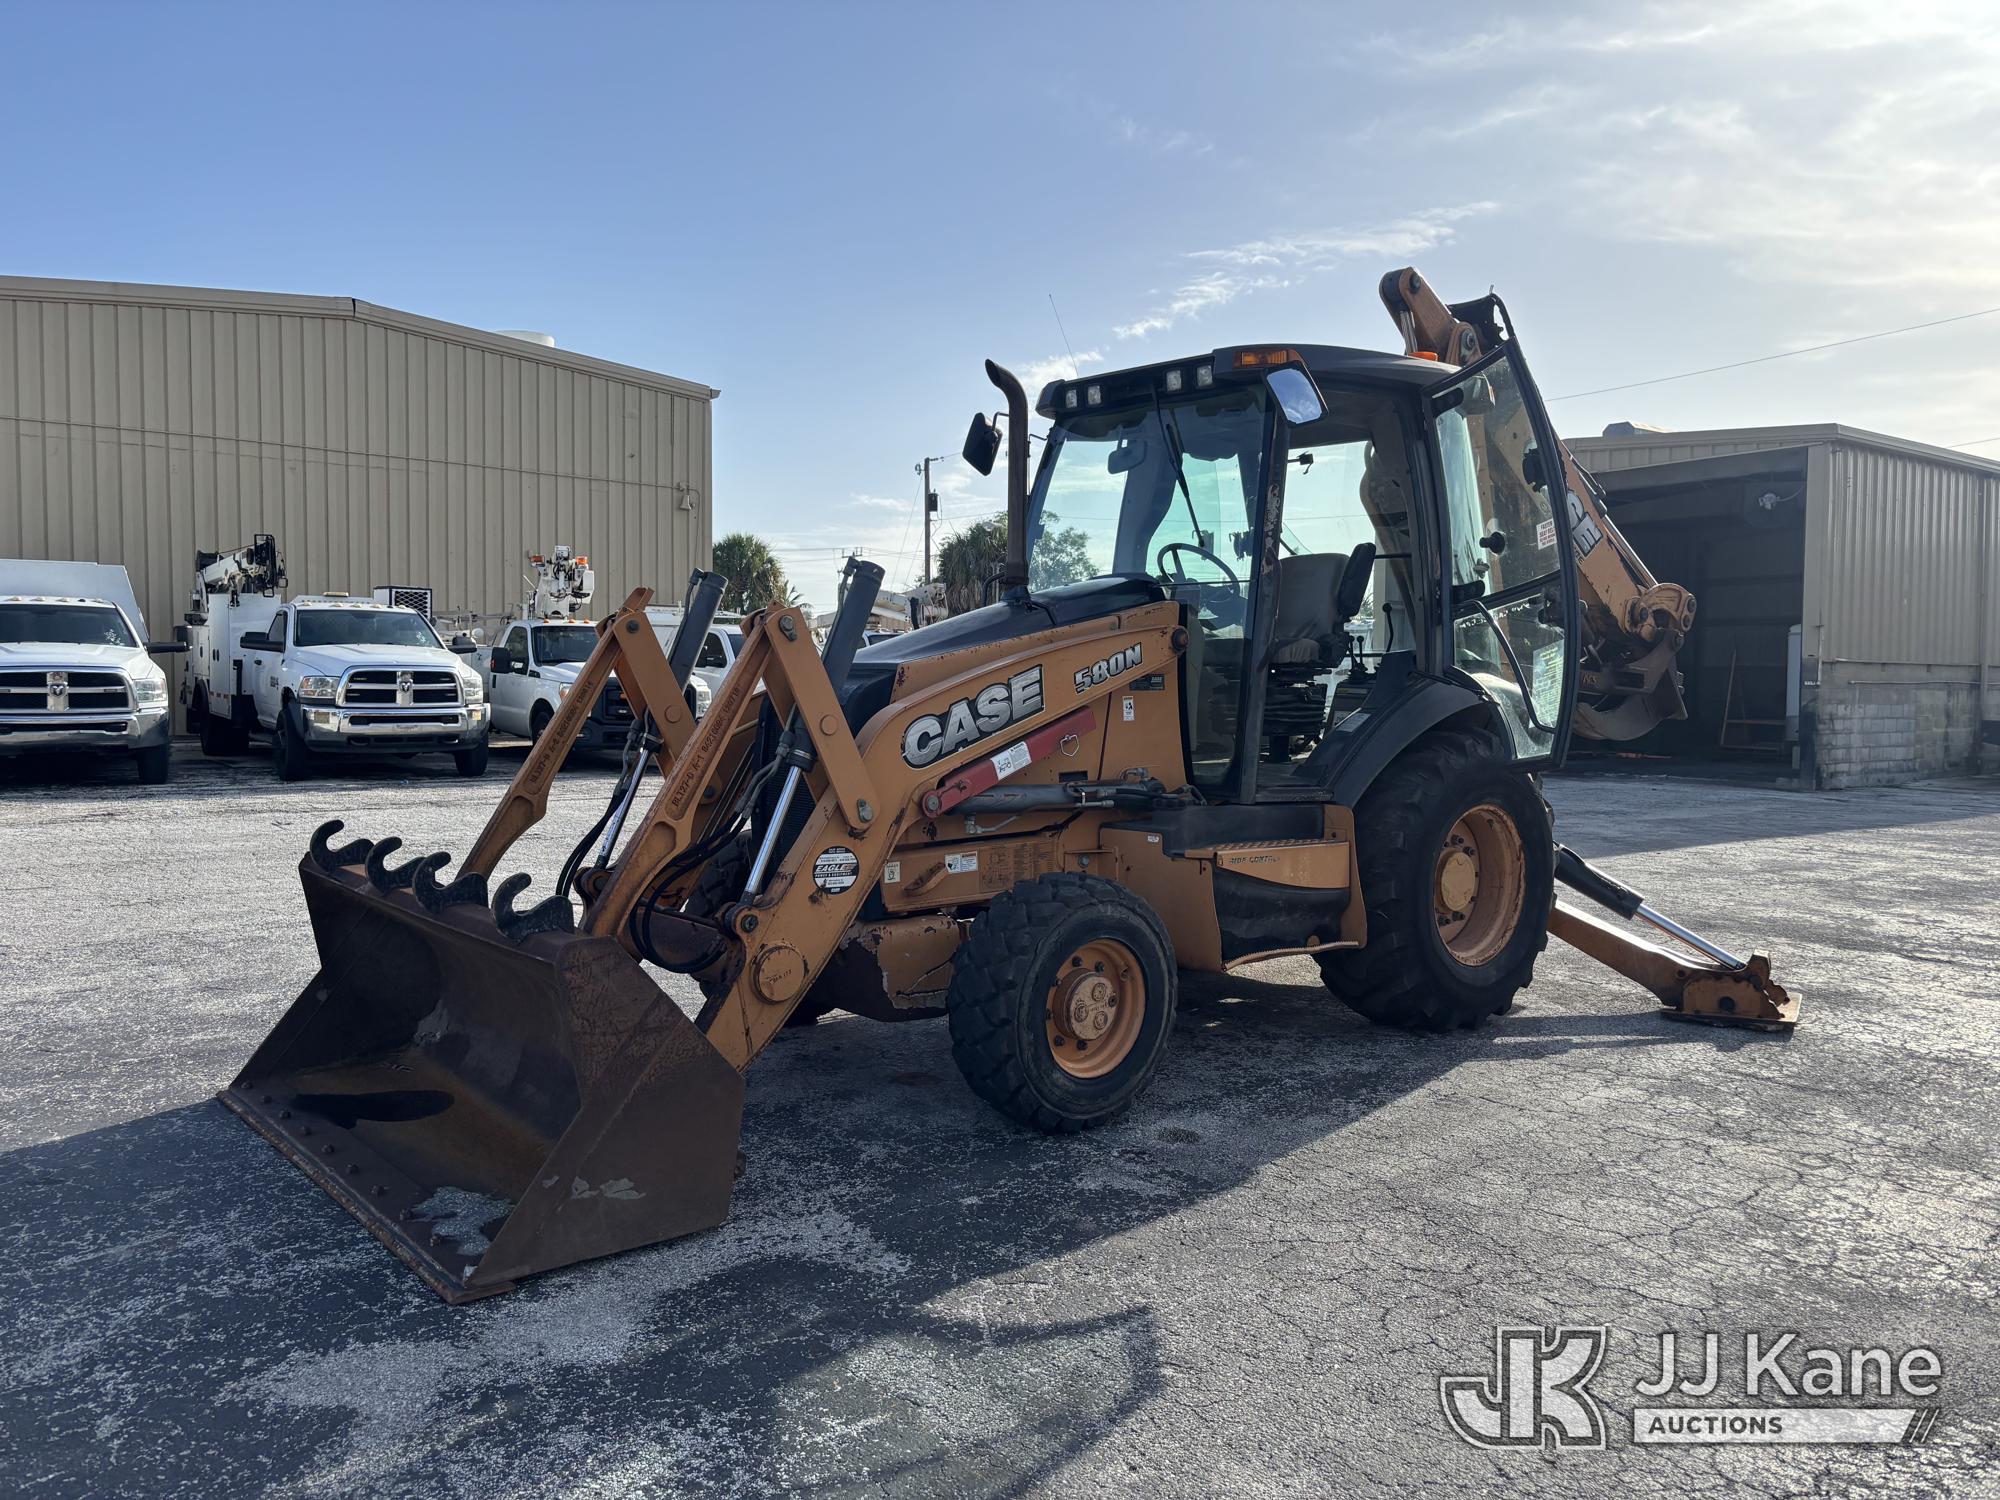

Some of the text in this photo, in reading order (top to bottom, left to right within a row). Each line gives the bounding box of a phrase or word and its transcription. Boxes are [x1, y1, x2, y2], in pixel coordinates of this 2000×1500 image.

[1074, 643, 1142, 695] 580N
[901, 664, 1045, 769] CASE
[816, 864, 847, 872] EAGLE
